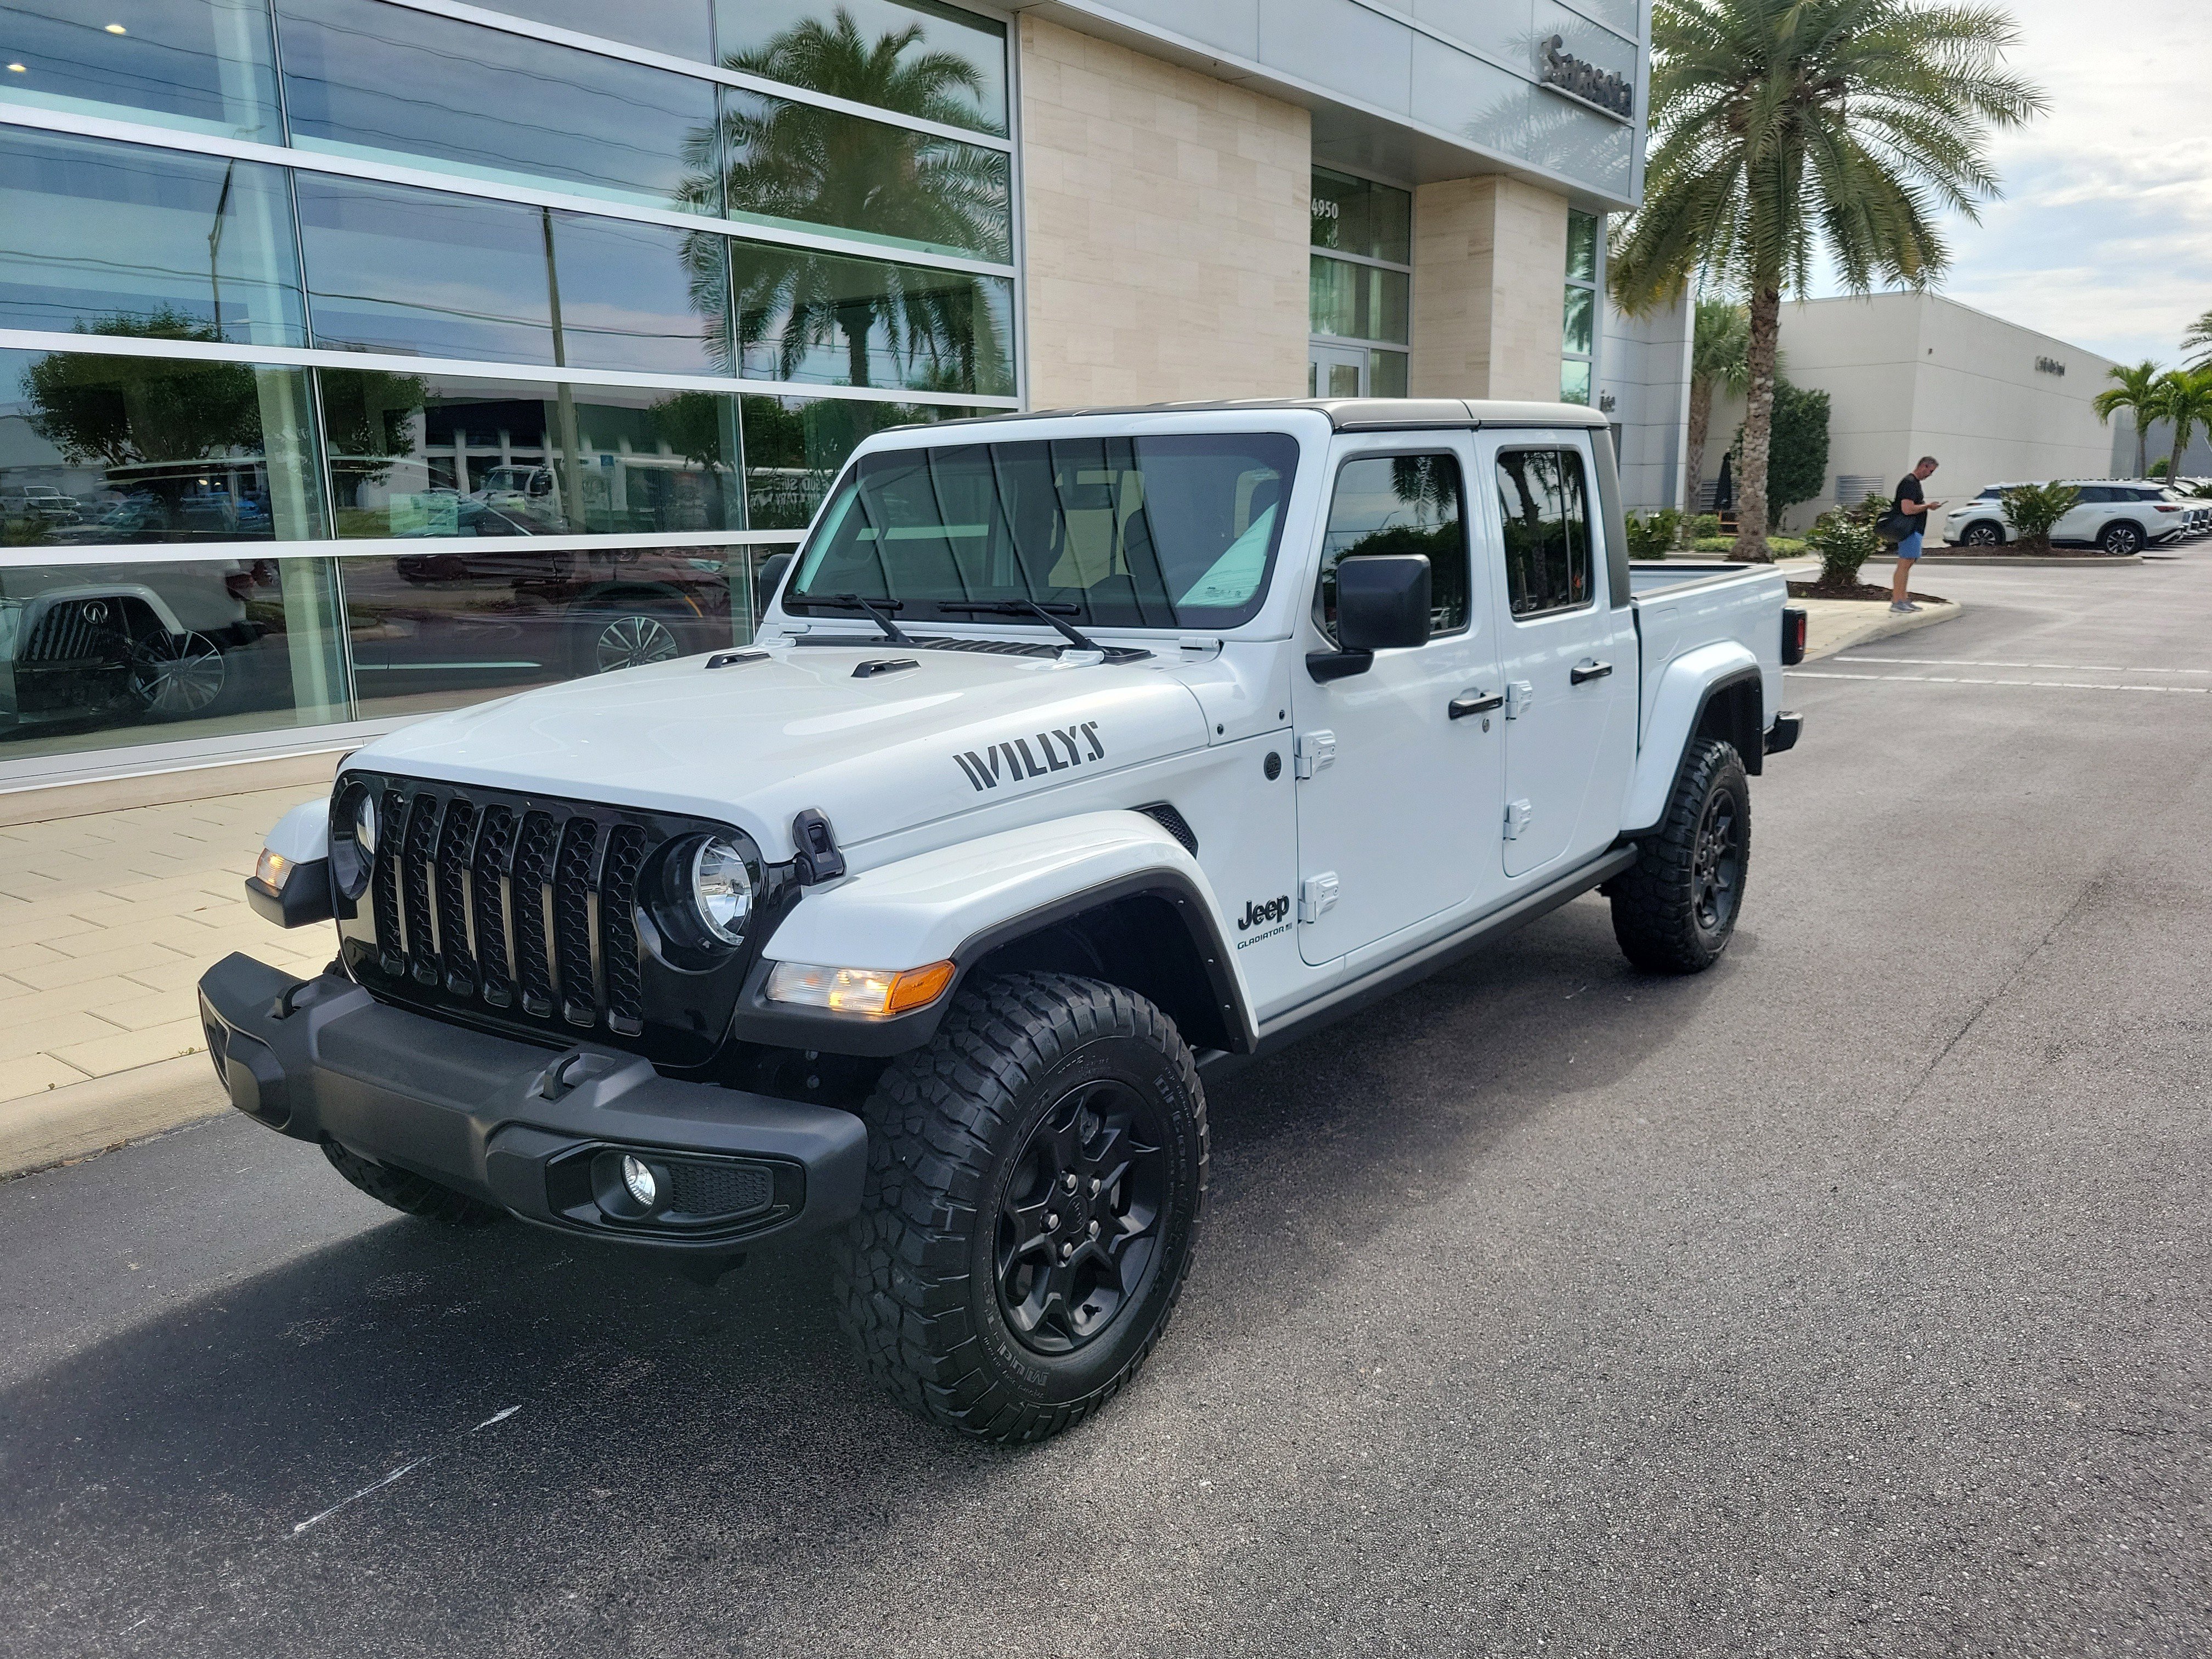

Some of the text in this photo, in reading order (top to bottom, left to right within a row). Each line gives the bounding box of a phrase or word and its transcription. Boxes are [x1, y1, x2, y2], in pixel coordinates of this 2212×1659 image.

[1311, 198, 1339, 219] 4950
[952, 721, 1104, 792] WILLYS
[1238, 895, 1289, 931] Jeep
[1237, 926, 1284, 950] GLADIATOR
